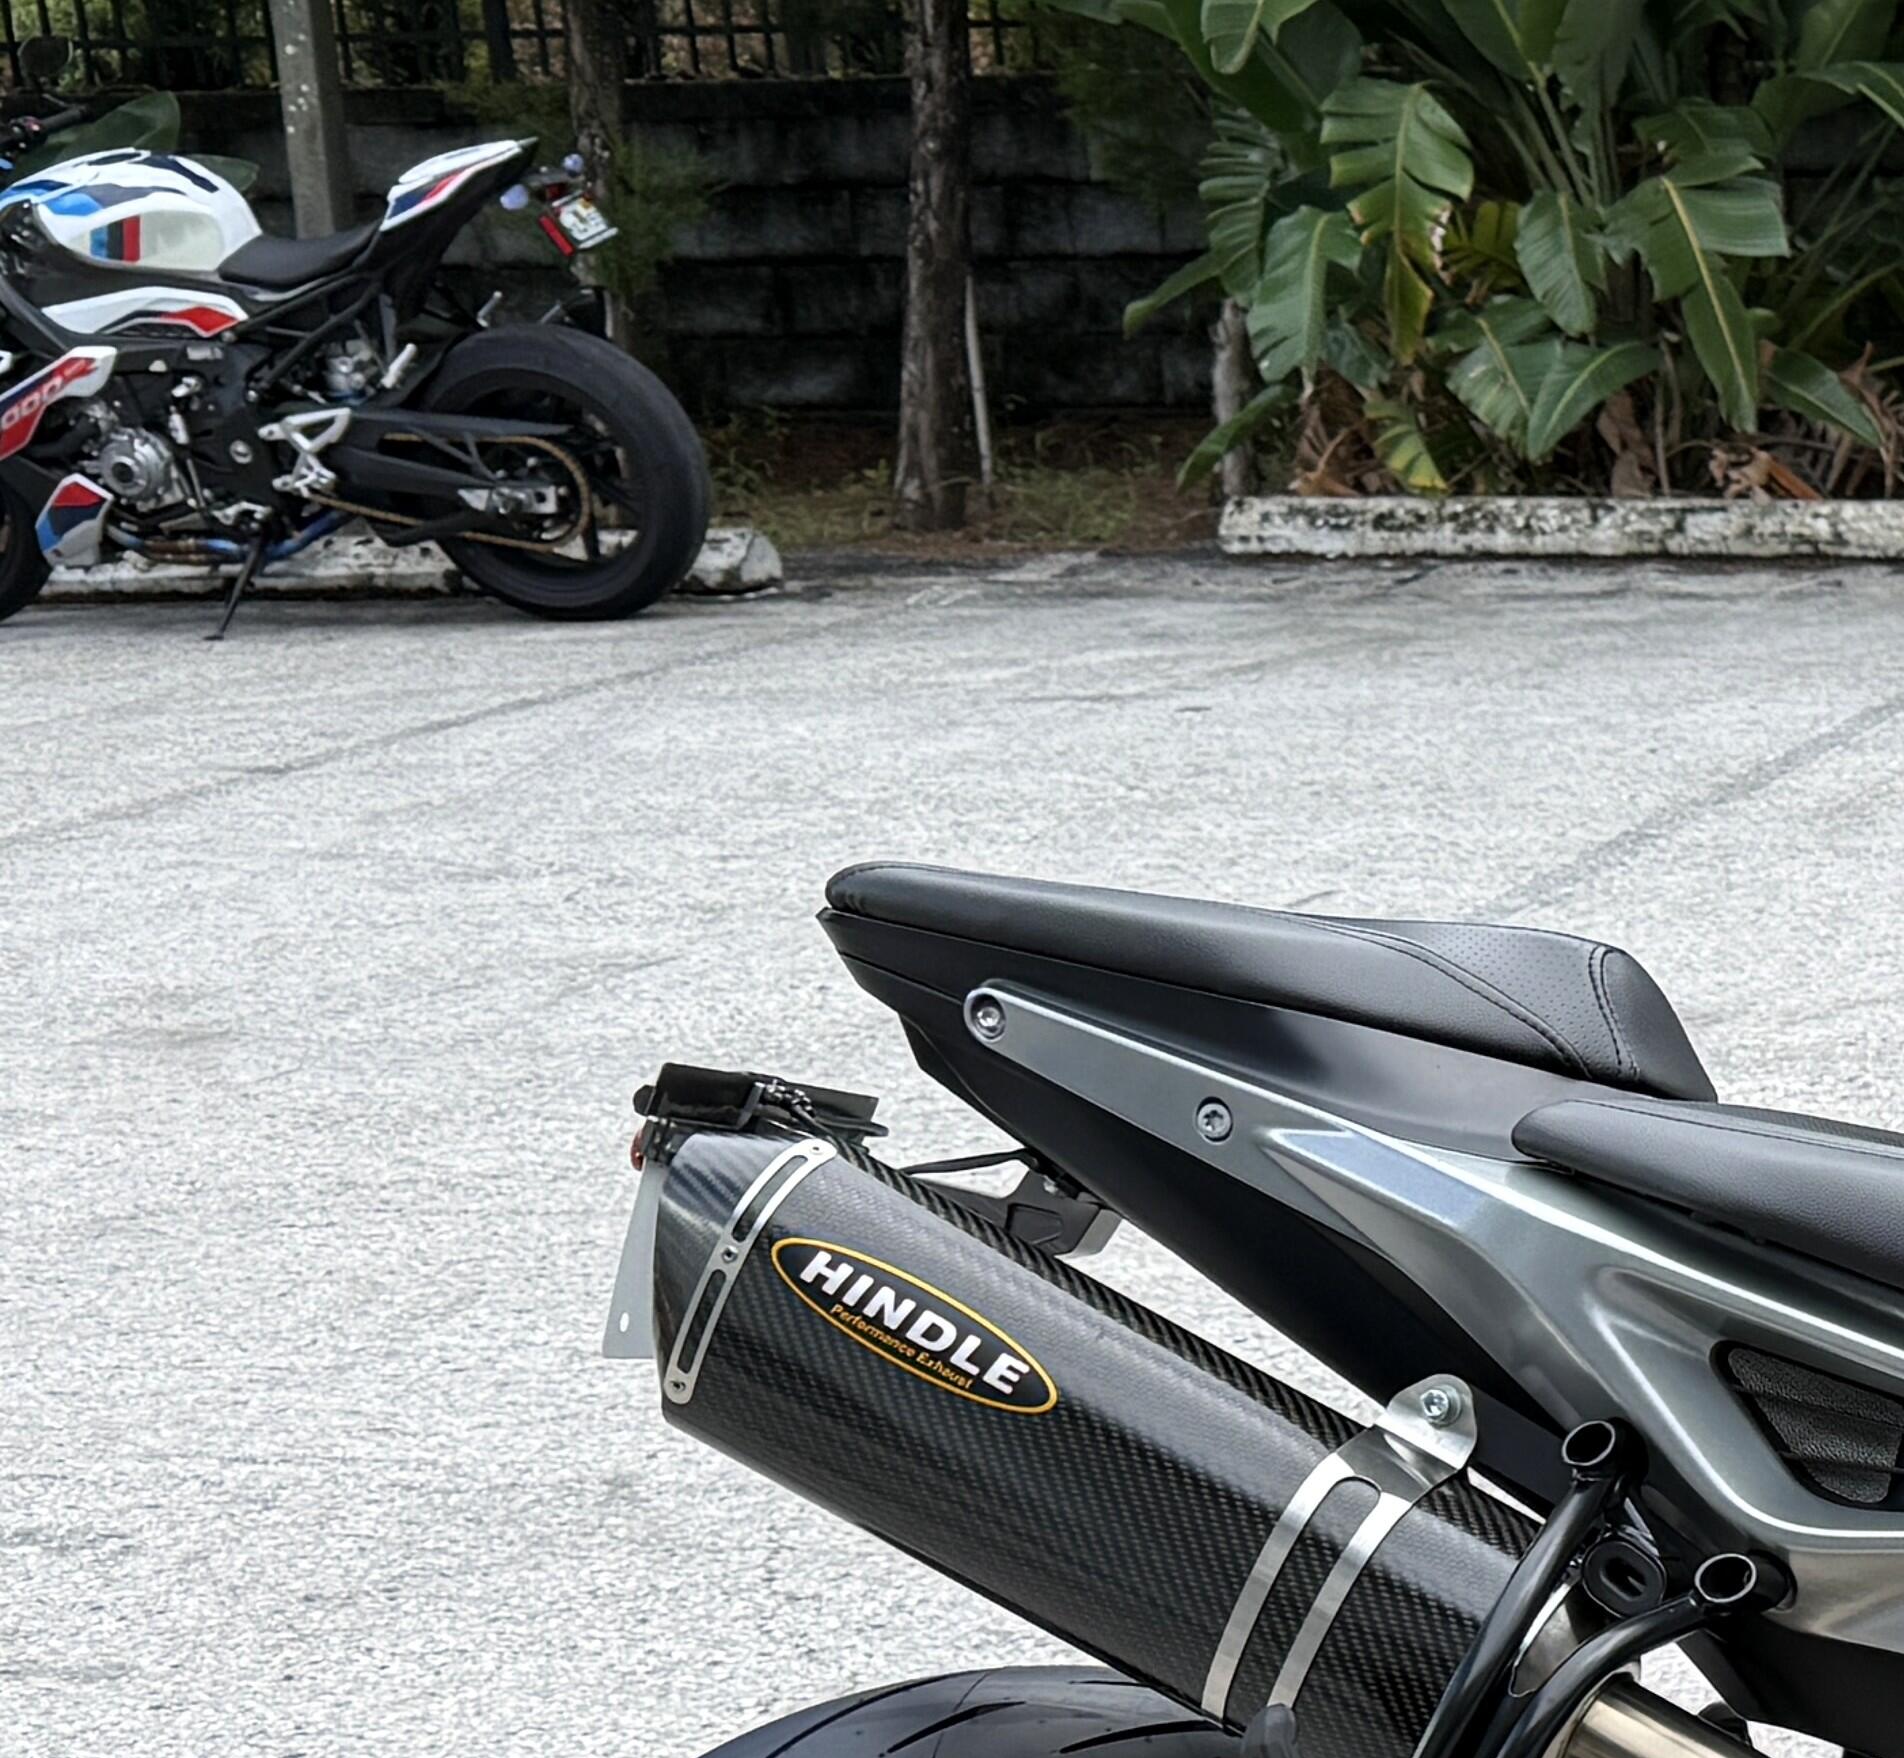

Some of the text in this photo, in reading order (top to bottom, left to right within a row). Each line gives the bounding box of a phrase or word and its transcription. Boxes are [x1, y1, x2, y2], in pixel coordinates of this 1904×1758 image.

[800, 1250, 1031, 1395] HINDLE
[830, 1303, 974, 1390] Performance Exhaust
